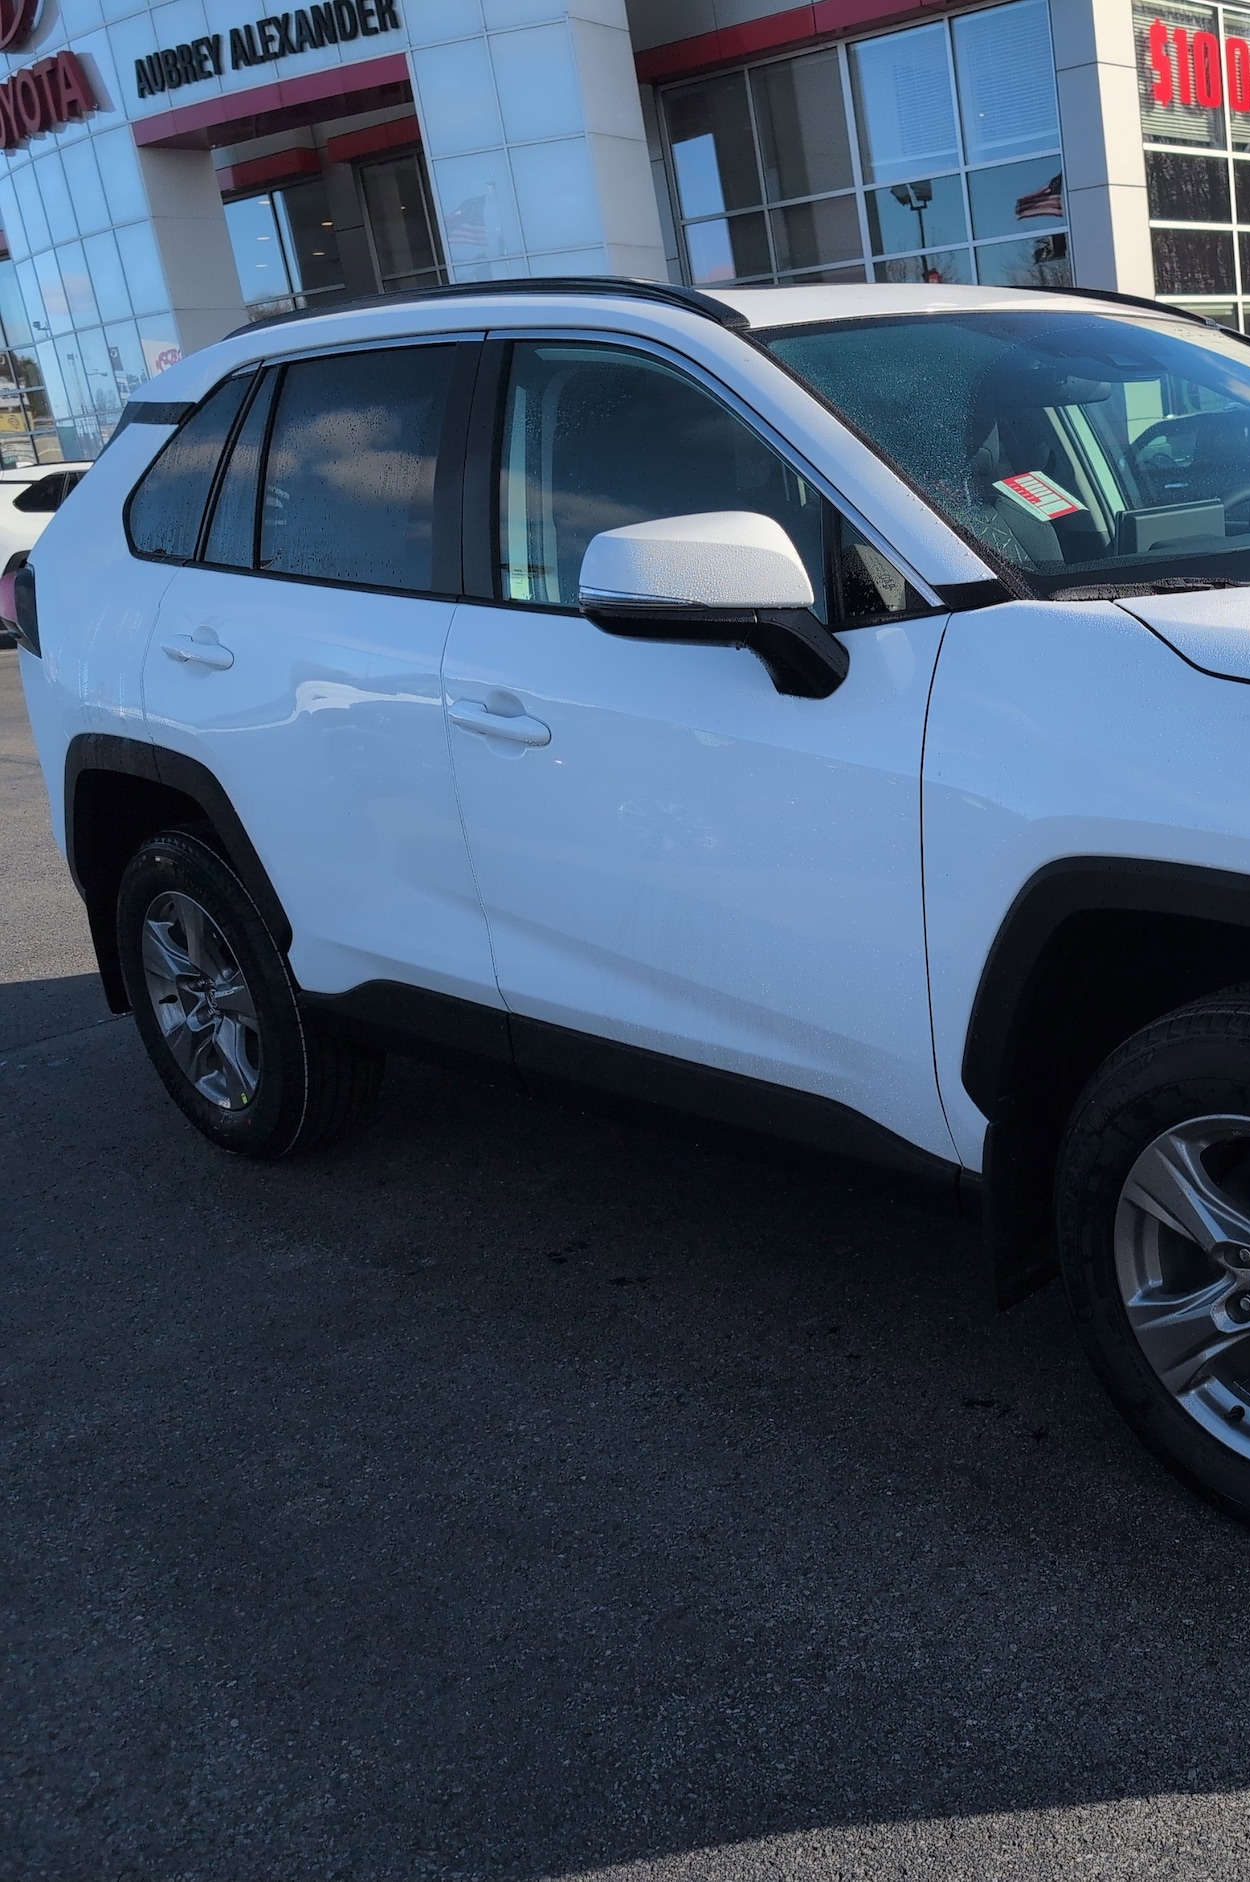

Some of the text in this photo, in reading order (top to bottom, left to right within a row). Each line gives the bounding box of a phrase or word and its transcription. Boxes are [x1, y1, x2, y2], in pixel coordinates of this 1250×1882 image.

[134, 0, 400, 98] AUBREY ALEXANDER
[0, 50, 96, 151] YOTA
